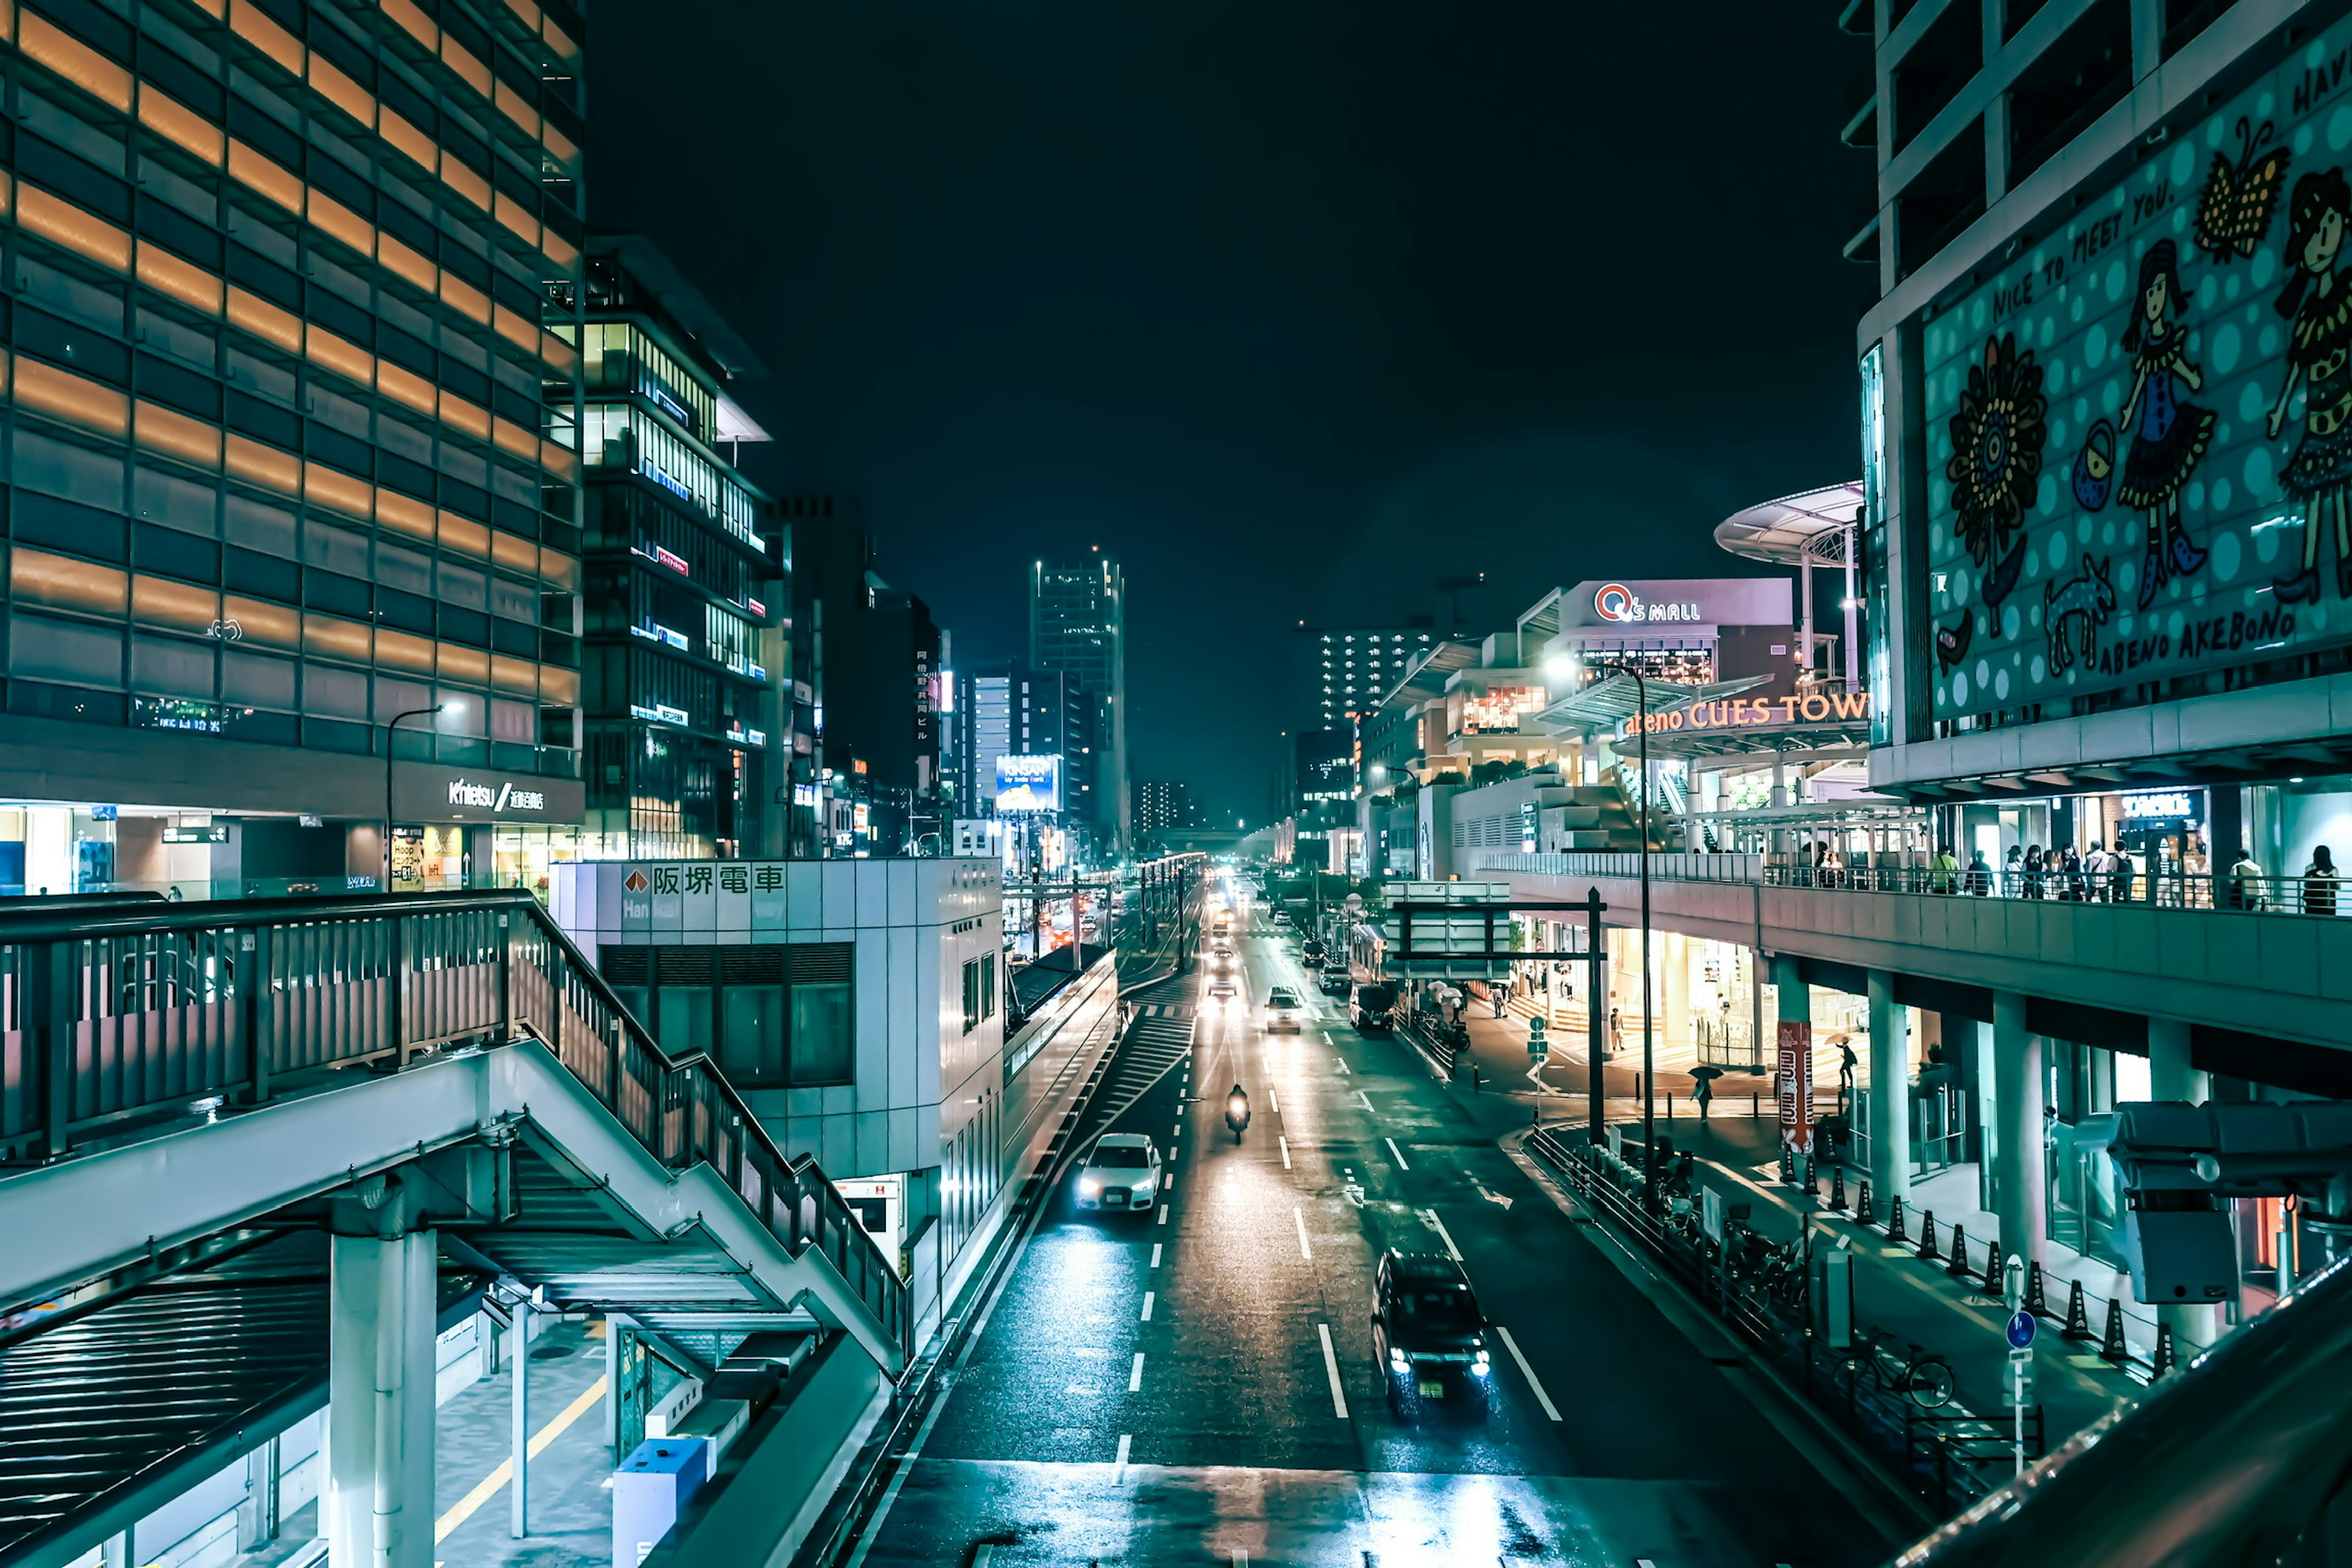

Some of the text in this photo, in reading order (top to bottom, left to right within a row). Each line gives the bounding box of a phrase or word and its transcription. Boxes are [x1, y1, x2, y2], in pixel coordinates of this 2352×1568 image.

[1993, 271, 2034, 324] NICE
[2044, 256, 2064, 285] TO
[2072, 210, 2124, 264] MEET
[1648, 603, 1700, 621] MALL
[2099, 603, 2294, 677] ABENO AKEBONO
[1689, 697, 1771, 728] CUES
[1779, 693, 1873, 722] TOW
[395, 845, 414, 855] Hoop
[654, 865, 784, 895] 阪堺電車
